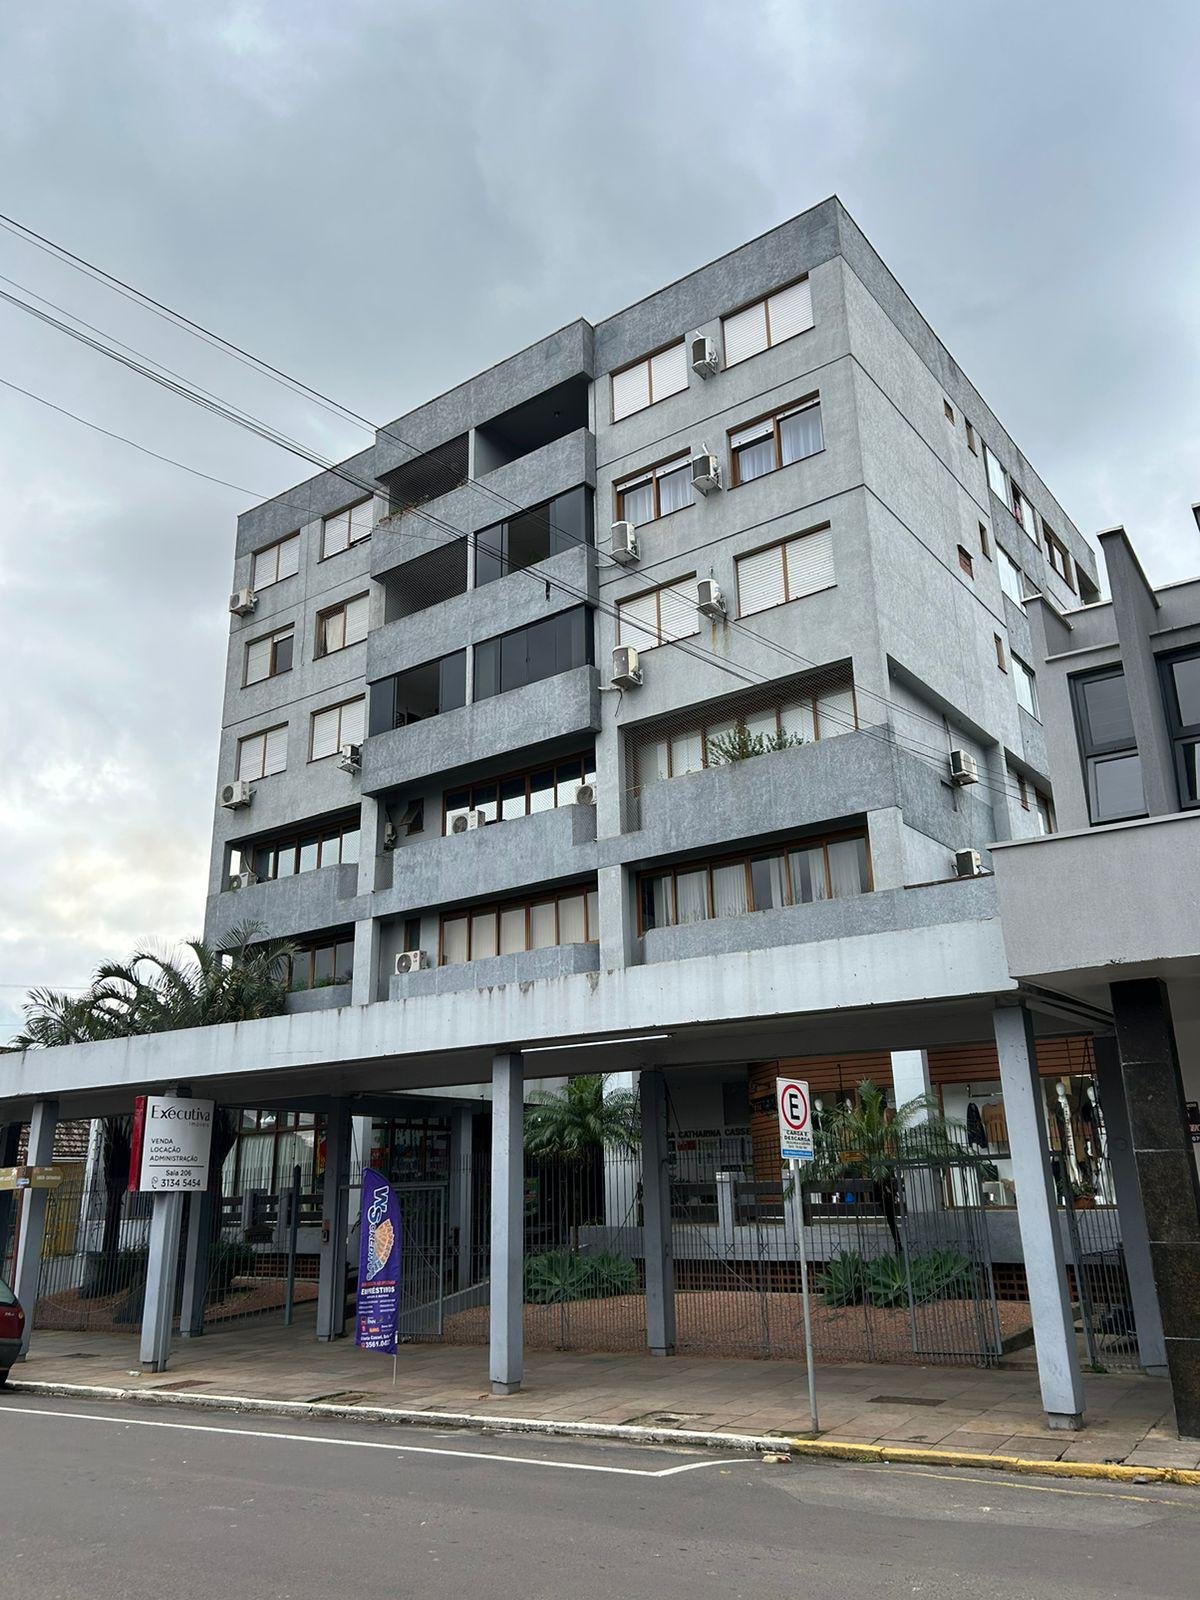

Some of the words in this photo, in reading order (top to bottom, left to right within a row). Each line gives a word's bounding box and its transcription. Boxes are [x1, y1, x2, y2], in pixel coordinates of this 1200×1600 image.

[151, 1105, 210, 1121] Executiva
[788, 1093, 800, 1120] E
[678, 1129, 721, 1138] CATHARINA
[161, 1179, 180, 1187] 3134
[182, 1179, 201, 1187] 5454
[368, 1185, 389, 1224] WS
